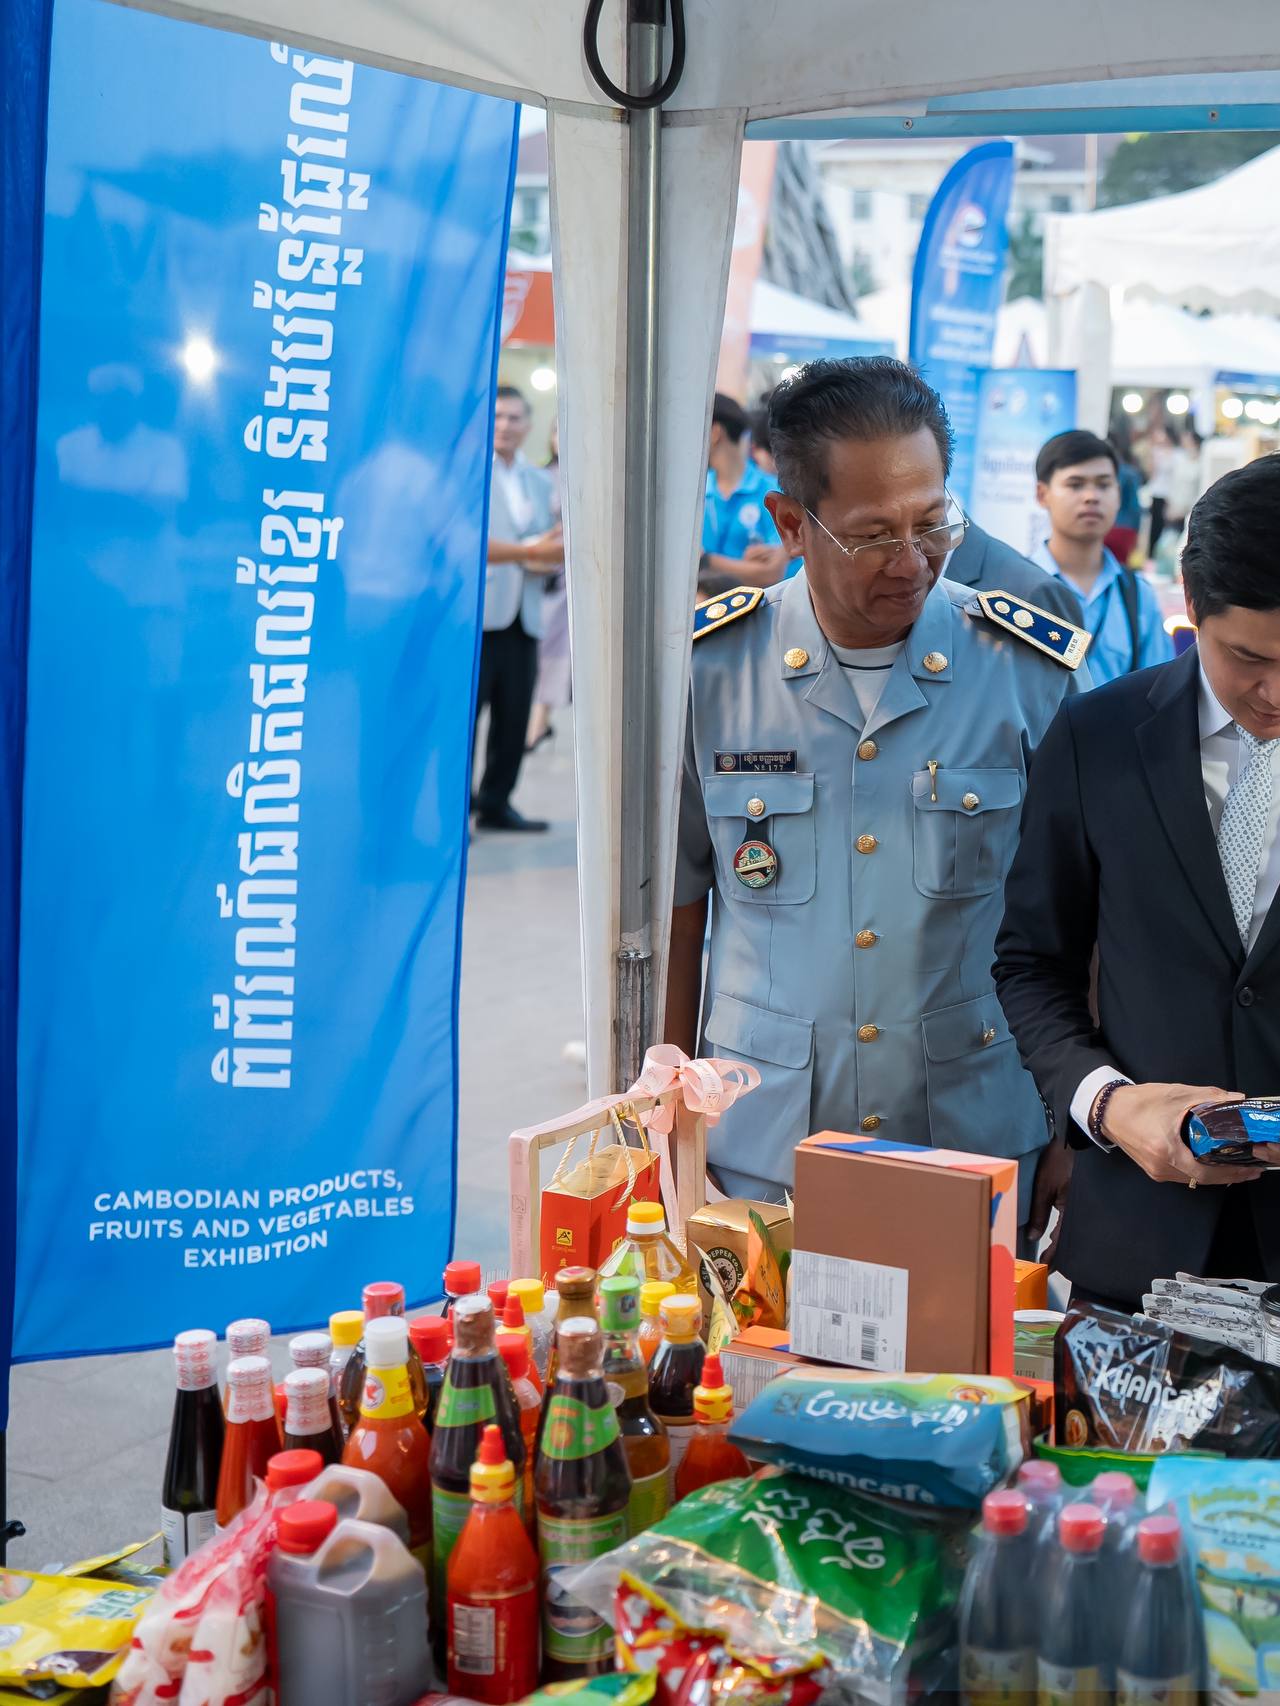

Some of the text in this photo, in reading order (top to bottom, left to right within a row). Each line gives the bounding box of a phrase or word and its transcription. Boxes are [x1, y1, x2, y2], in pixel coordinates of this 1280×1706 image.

[94, 1168, 404, 1214] CAMBODIAN PRODUCTS,
[89, 1195, 415, 1242] FRUITS AND VEGETABLES
[183, 1228, 328, 1269] EXHIBITION
